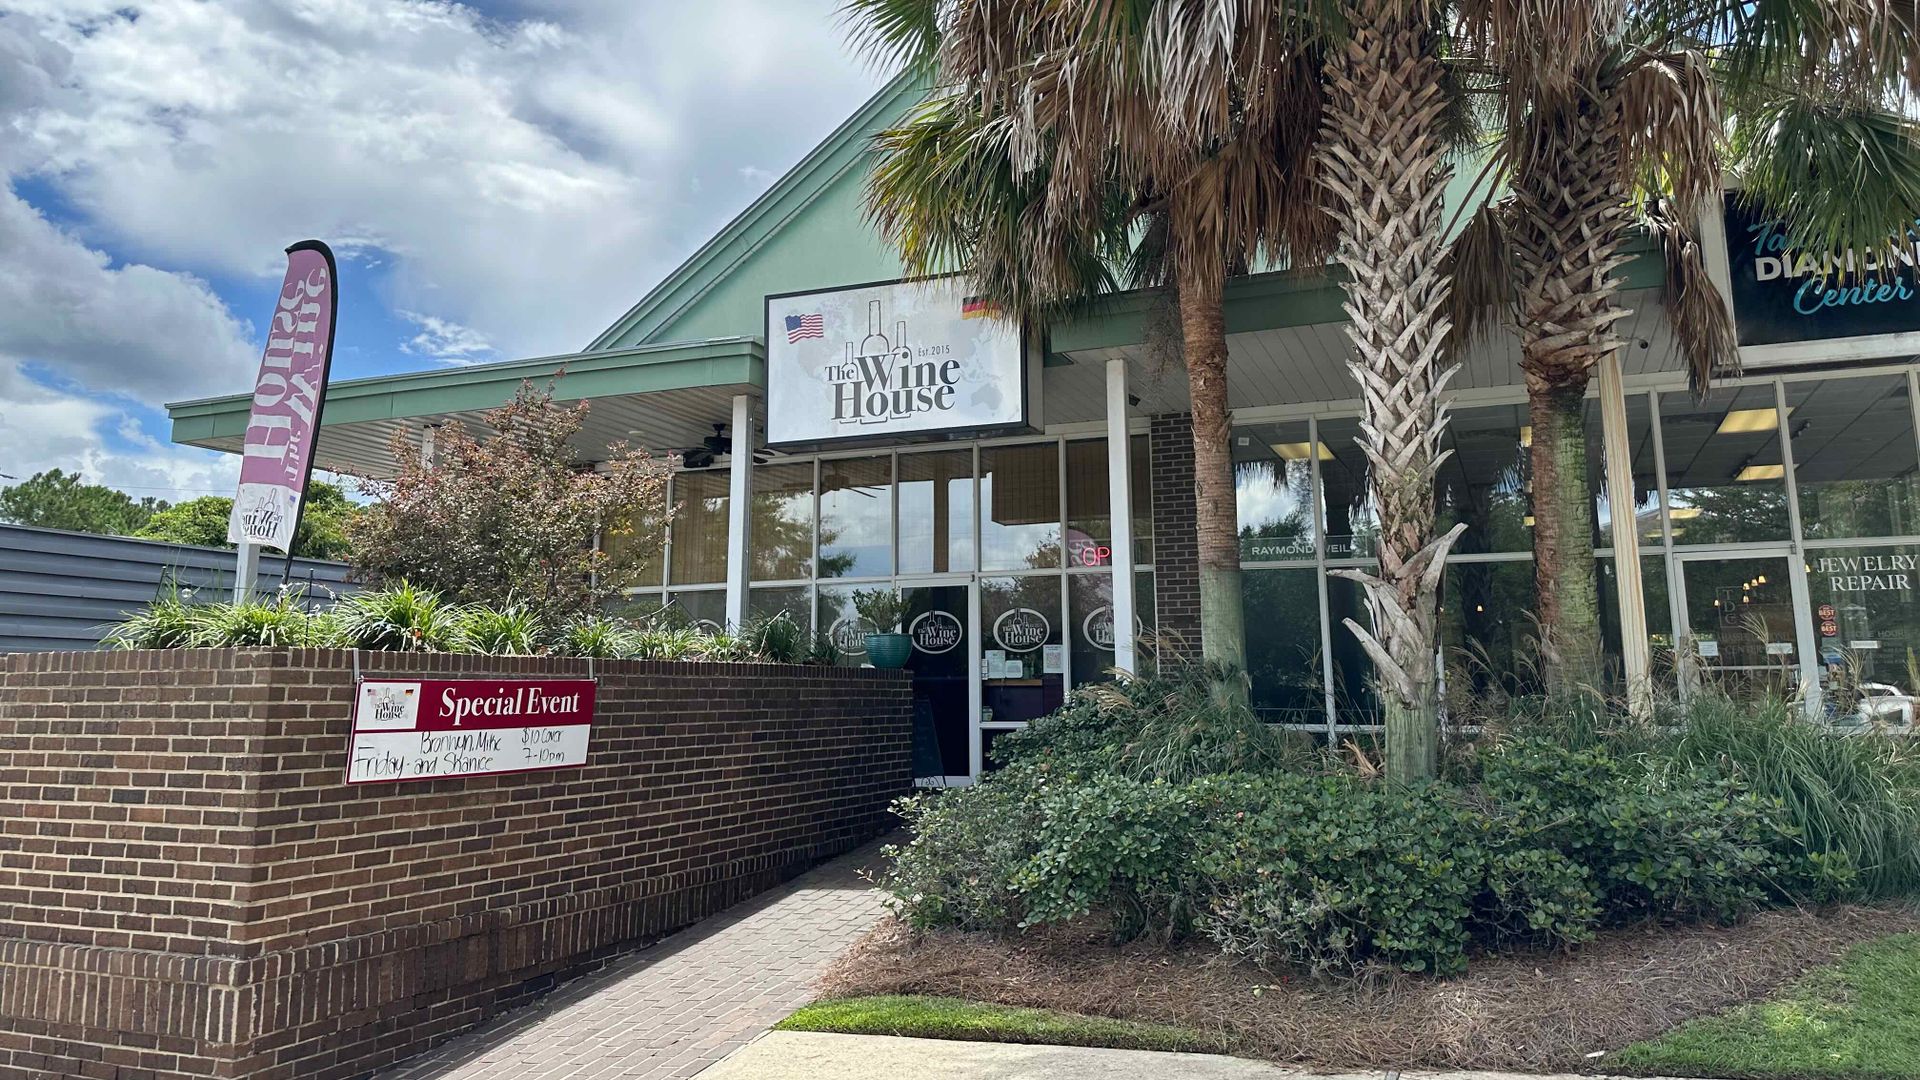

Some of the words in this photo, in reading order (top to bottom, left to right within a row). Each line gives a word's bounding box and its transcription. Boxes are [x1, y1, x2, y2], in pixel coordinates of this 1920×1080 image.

[1793, 275, 1914, 315] Center
[825, 365, 855, 382] The
[855, 351, 961, 393] Wine
[831, 380, 956, 421] House
[1082, 546, 1110, 566] OP
[1252, 545, 1314, 555] RAYMOND
[1817, 555, 1919, 574] JEWELRY
[1831, 574, 1911, 592] REPAIR
[927, 626, 957, 639] Wine
[1004, 632, 1042, 644] House
[1012, 623, 1044, 636] Wine
[919, 635, 956, 647] House
[375, 708, 403, 719] House
[382, 702, 405, 713] Wine
[439, 687, 523, 726] Special
[525, 686, 581, 715] Event
[522, 727, 540, 745] $10
[414, 756, 438, 775] and
